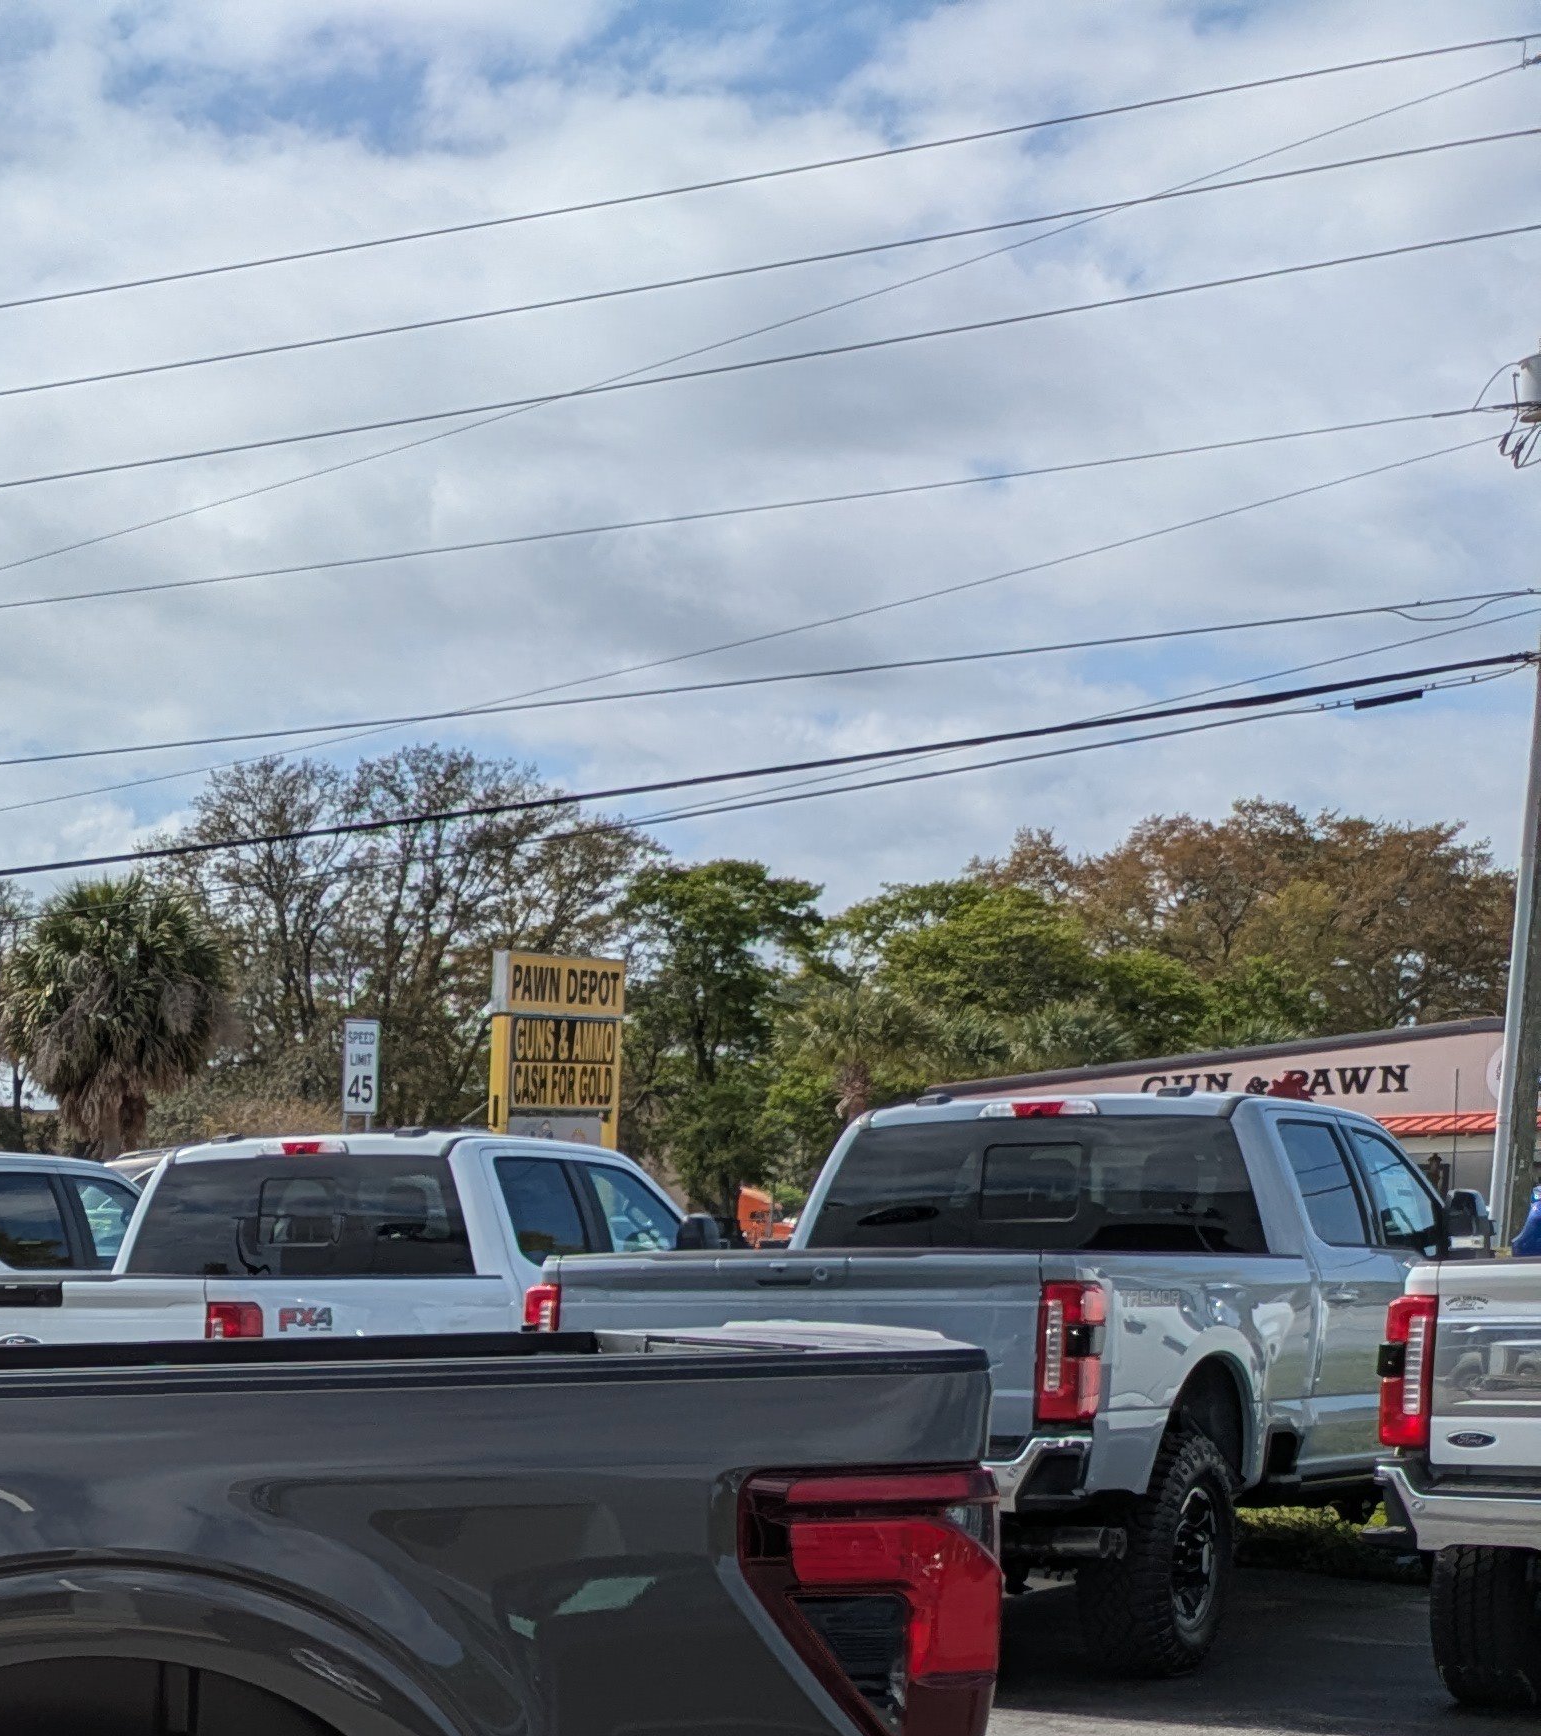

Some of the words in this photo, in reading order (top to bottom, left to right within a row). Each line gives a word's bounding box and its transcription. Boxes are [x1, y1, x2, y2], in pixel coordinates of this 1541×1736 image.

[512, 964, 561, 1003] PAWN
[566, 968, 620, 1007] DEPOT
[347, 1031, 375, 1045] SPEED
[516, 1018, 556, 1061] GUNS
[558, 1018, 569, 1062] &
[572, 1021, 614, 1062] AMMO
[349, 1053, 373, 1066] LIMIT
[347, 1074, 373, 1104] 45
[513, 1065, 548, 1105] CASH
[551, 1066, 576, 1105] FOR
[579, 1066, 614, 1105] GOLD
[1245, 1076, 1269, 1095] &
[1120, 1290, 1180, 1307] TREMOR
